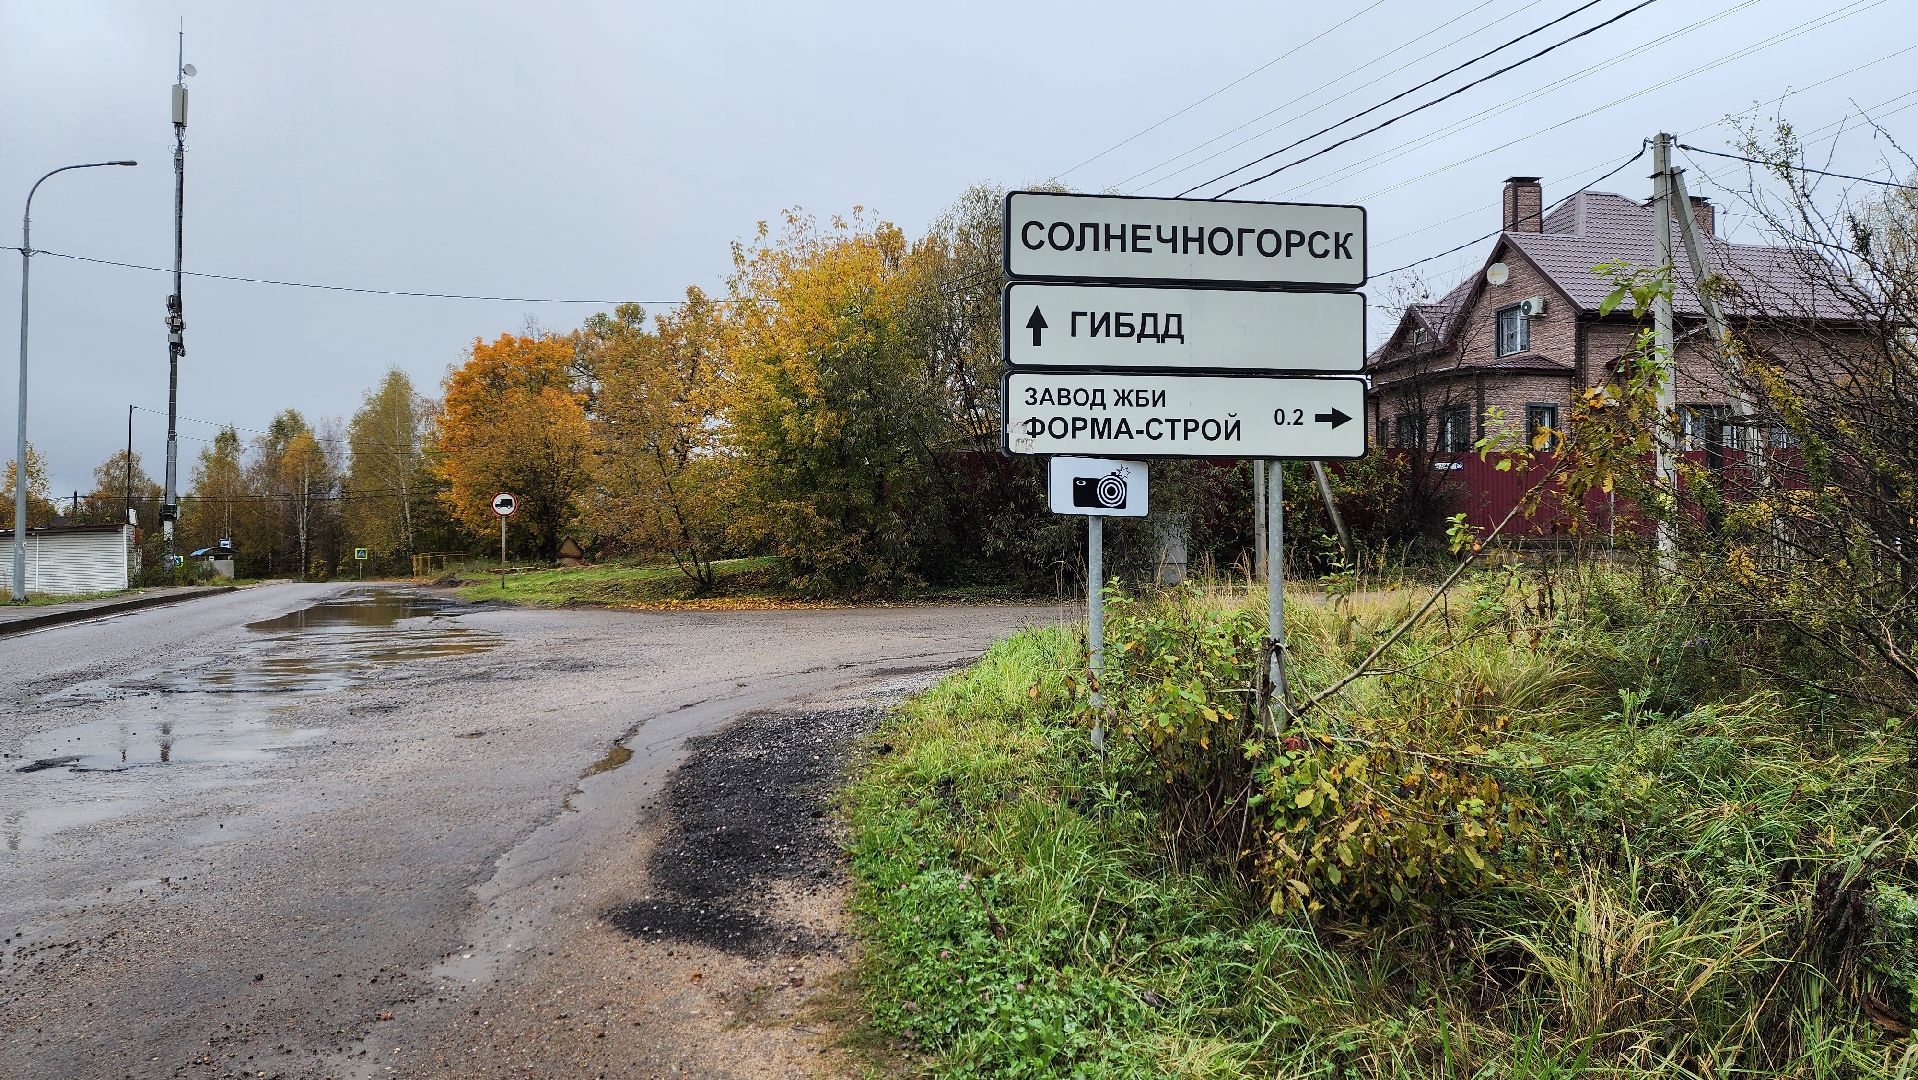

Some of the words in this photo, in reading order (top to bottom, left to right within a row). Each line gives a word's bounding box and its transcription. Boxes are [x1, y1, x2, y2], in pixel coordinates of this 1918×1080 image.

[1022, 220, 1354, 260] СОЛНЕЧНОГОРСК
[1071, 311, 1185, 344] ГИБДД
[1024, 387, 1107, 410] ЗАВОД
[1113, 388, 1166, 408] ЖБИ
[1023, 412, 1241, 441] ФОРМА-СТРОЙ
[1273, 409, 1304, 426] 0.2
